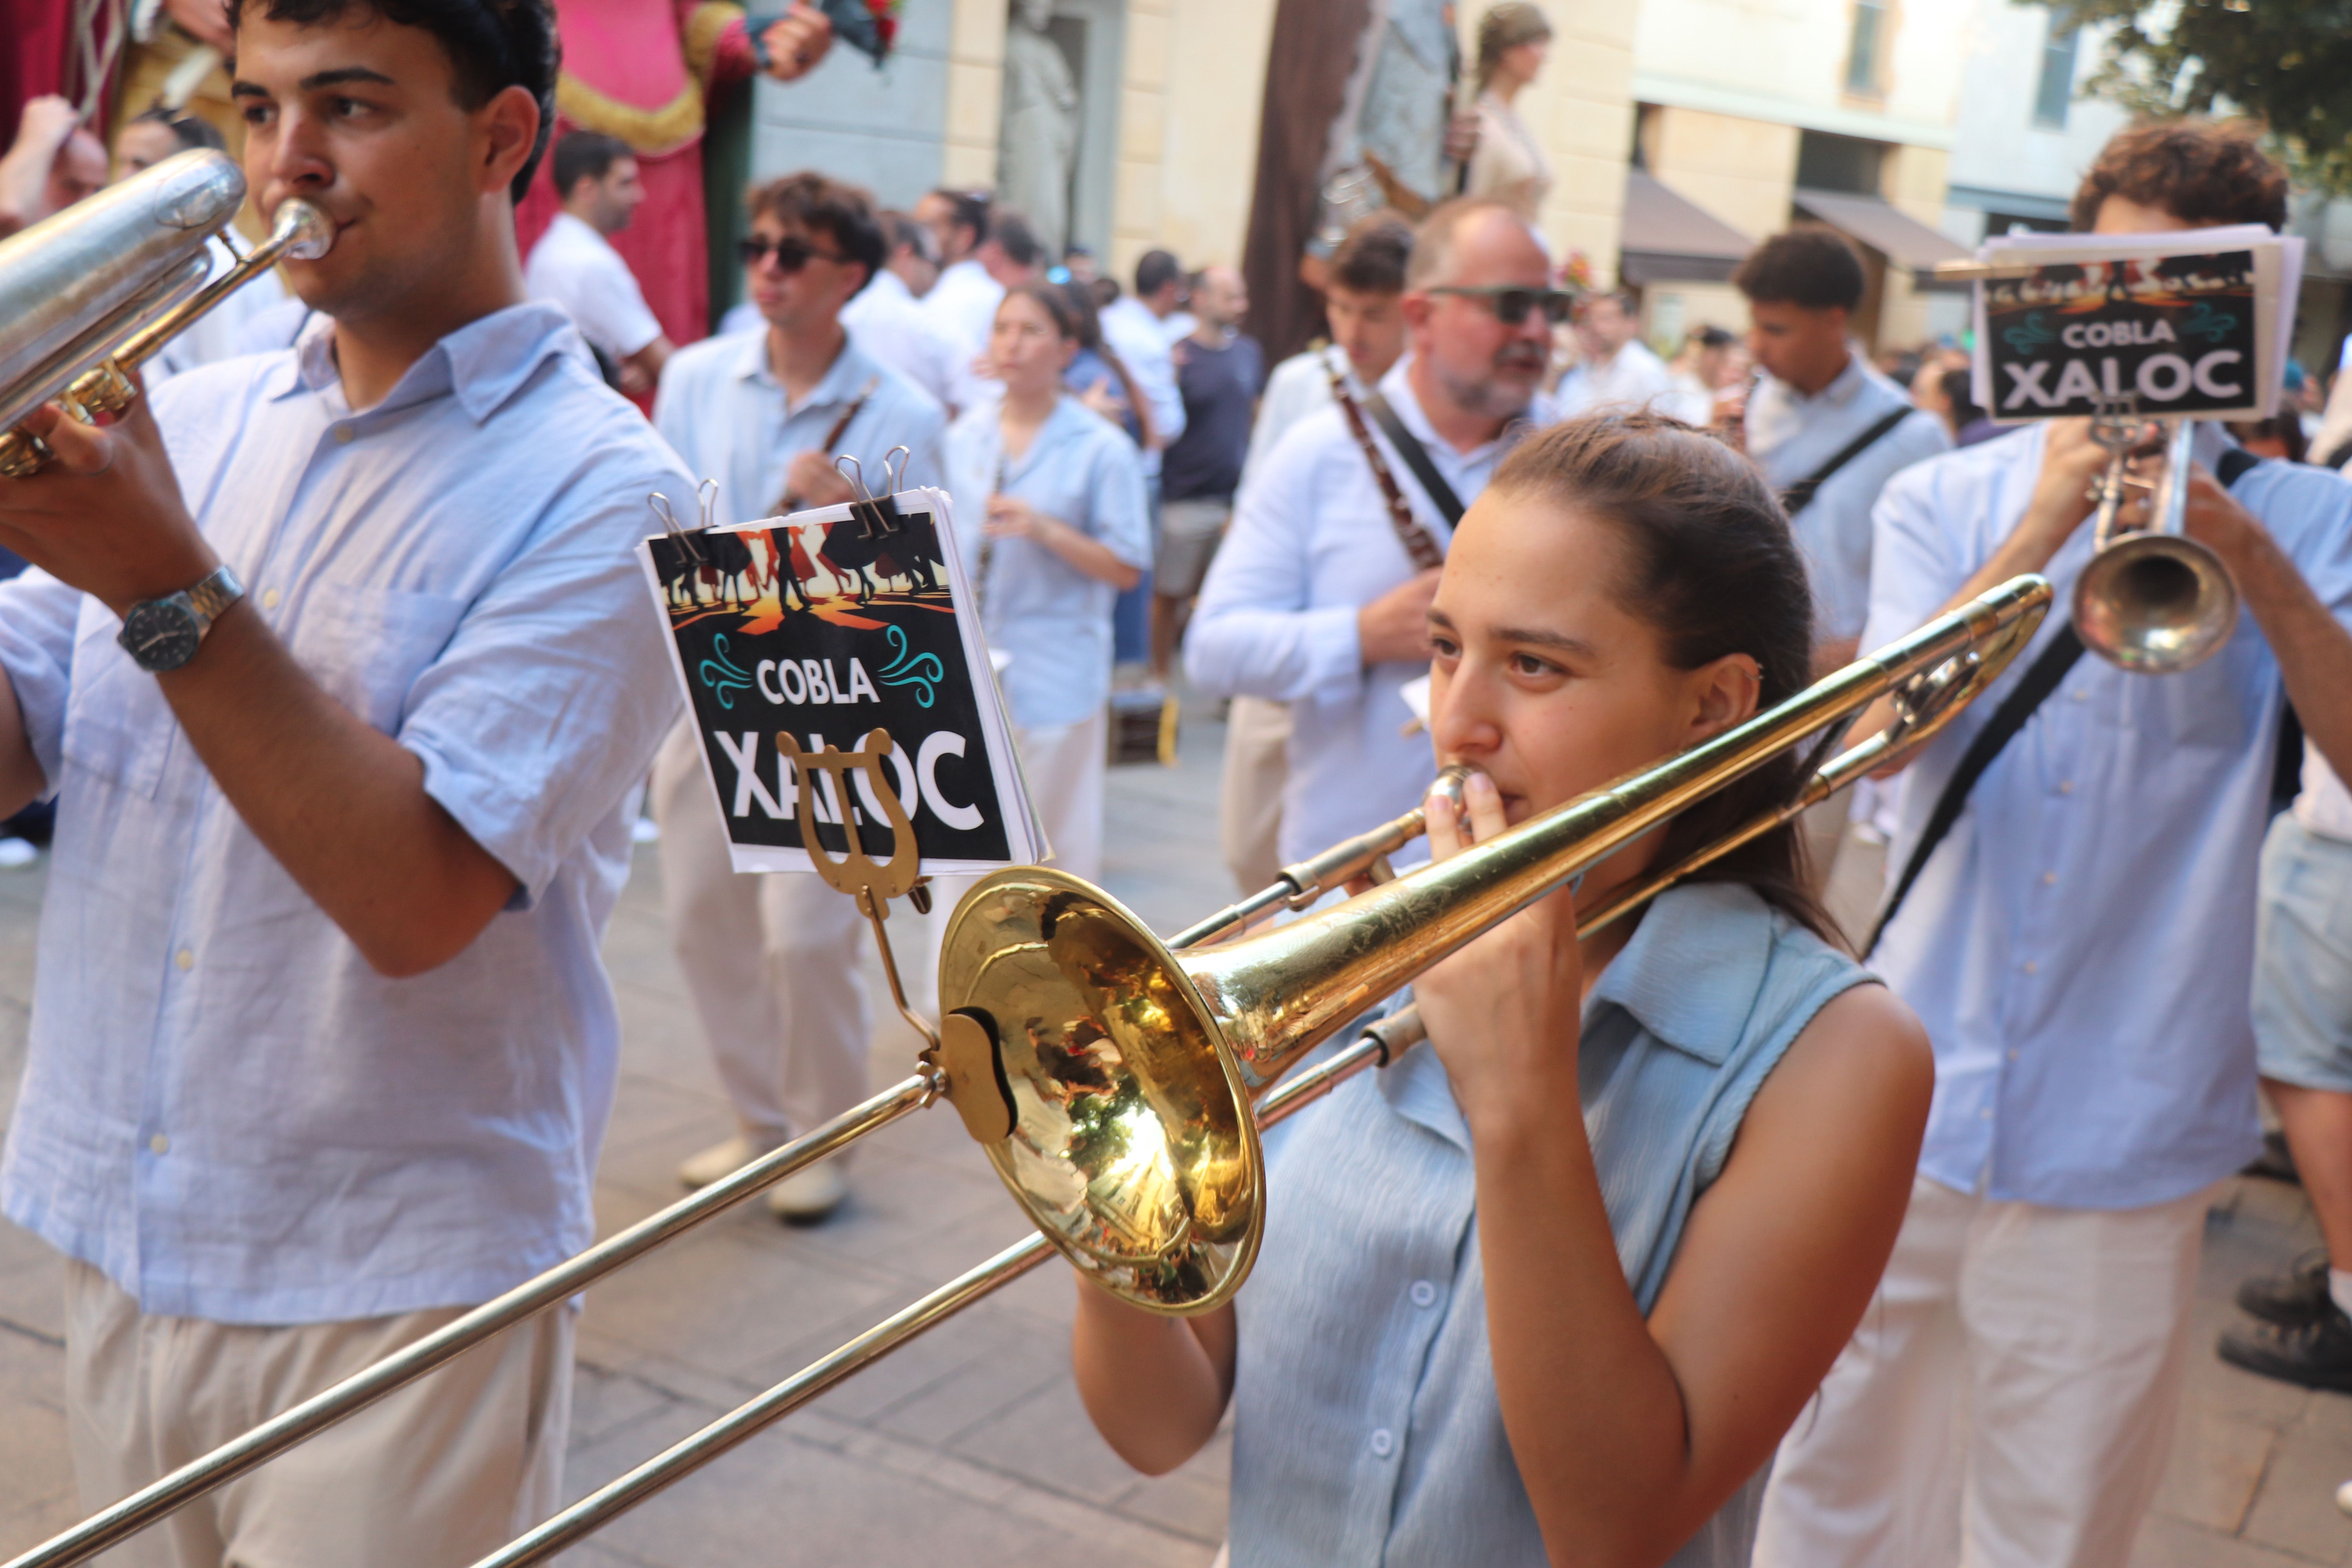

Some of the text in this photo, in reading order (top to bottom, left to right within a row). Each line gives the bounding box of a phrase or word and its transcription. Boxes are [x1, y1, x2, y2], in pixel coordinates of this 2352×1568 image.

[2062, 319, 2176, 348] COBLA
[2003, 349, 2243, 409] XALOC
[757, 657, 880, 705] COBLA
